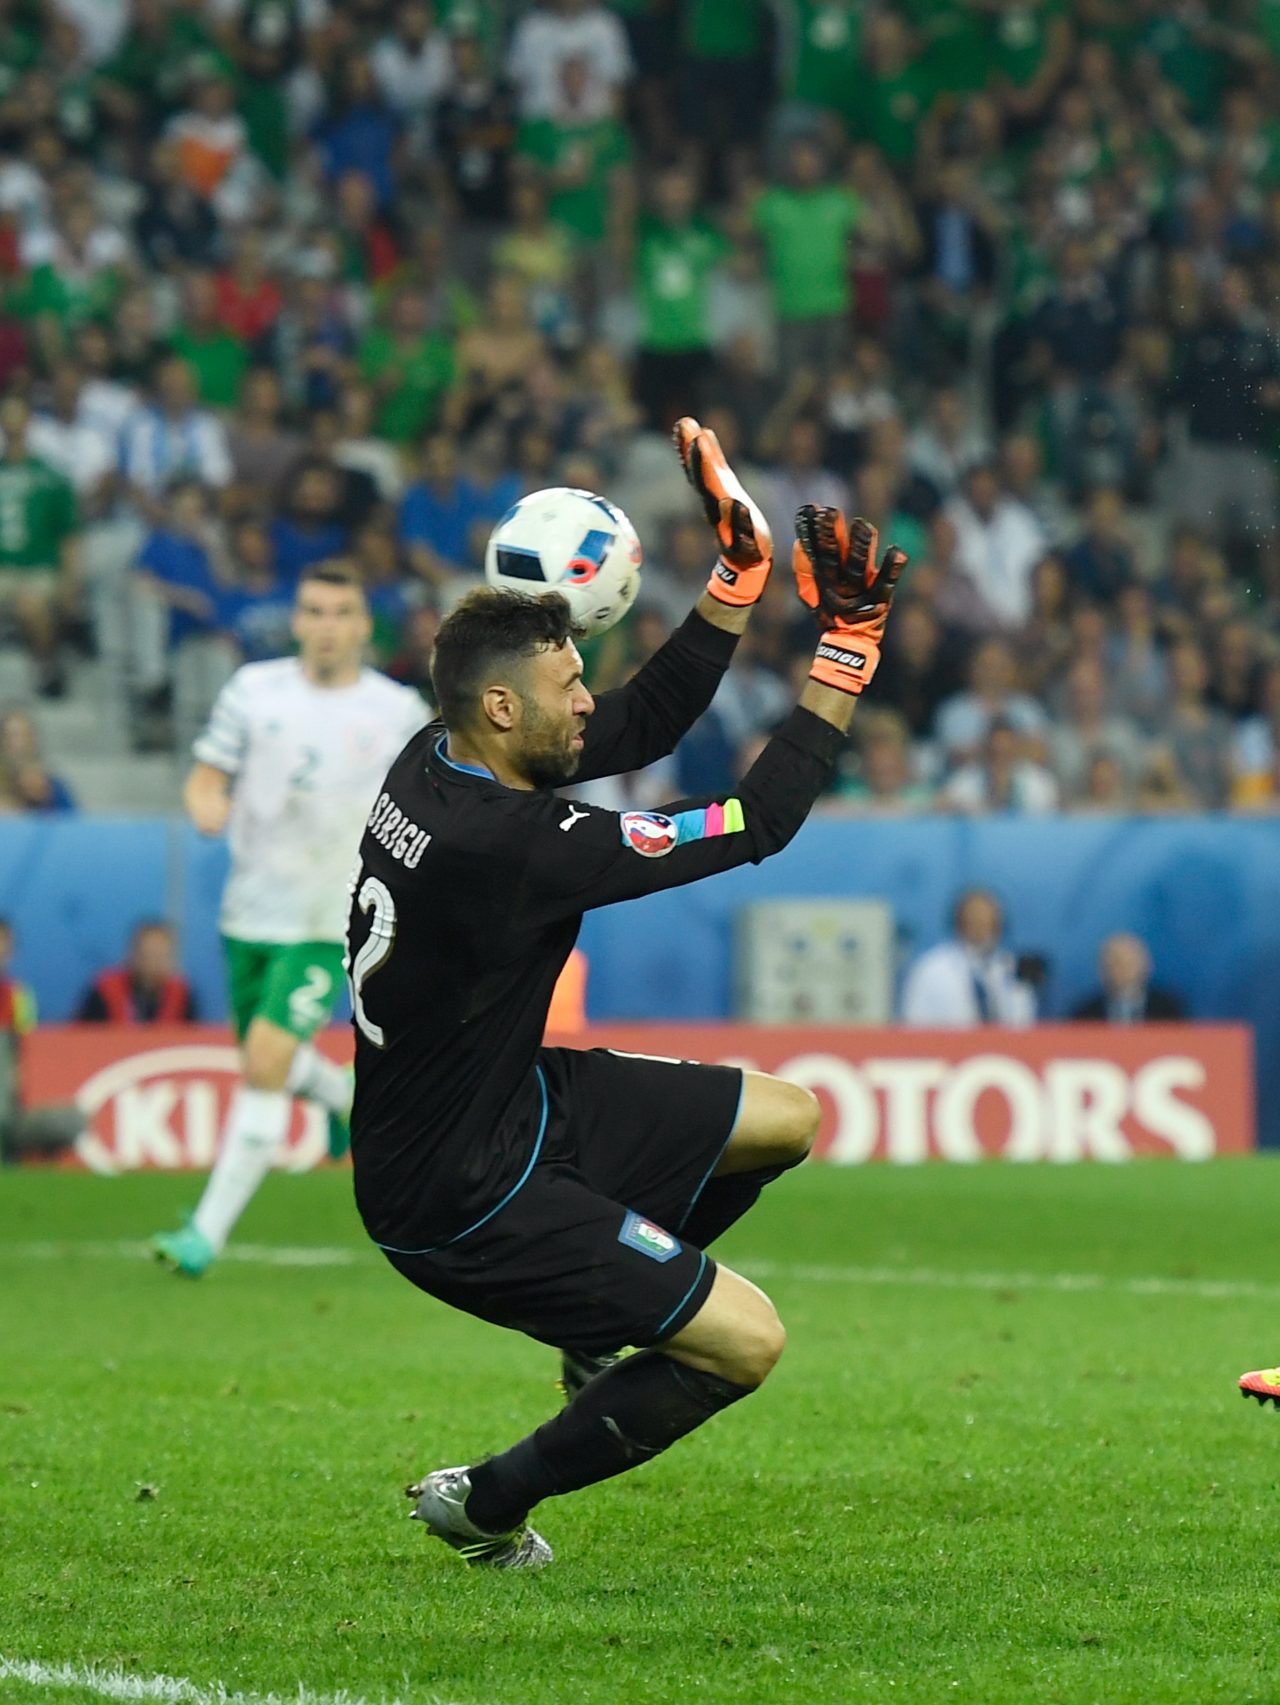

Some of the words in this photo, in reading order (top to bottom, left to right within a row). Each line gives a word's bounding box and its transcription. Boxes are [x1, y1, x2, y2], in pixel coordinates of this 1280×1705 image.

[289, 745, 323, 793] 2
[367, 792, 433, 869] SIRIGU
[343, 850, 397, 1050] 2
[288, 963, 333, 1020] 2
[716, 1053, 1217, 1166] OTORS
